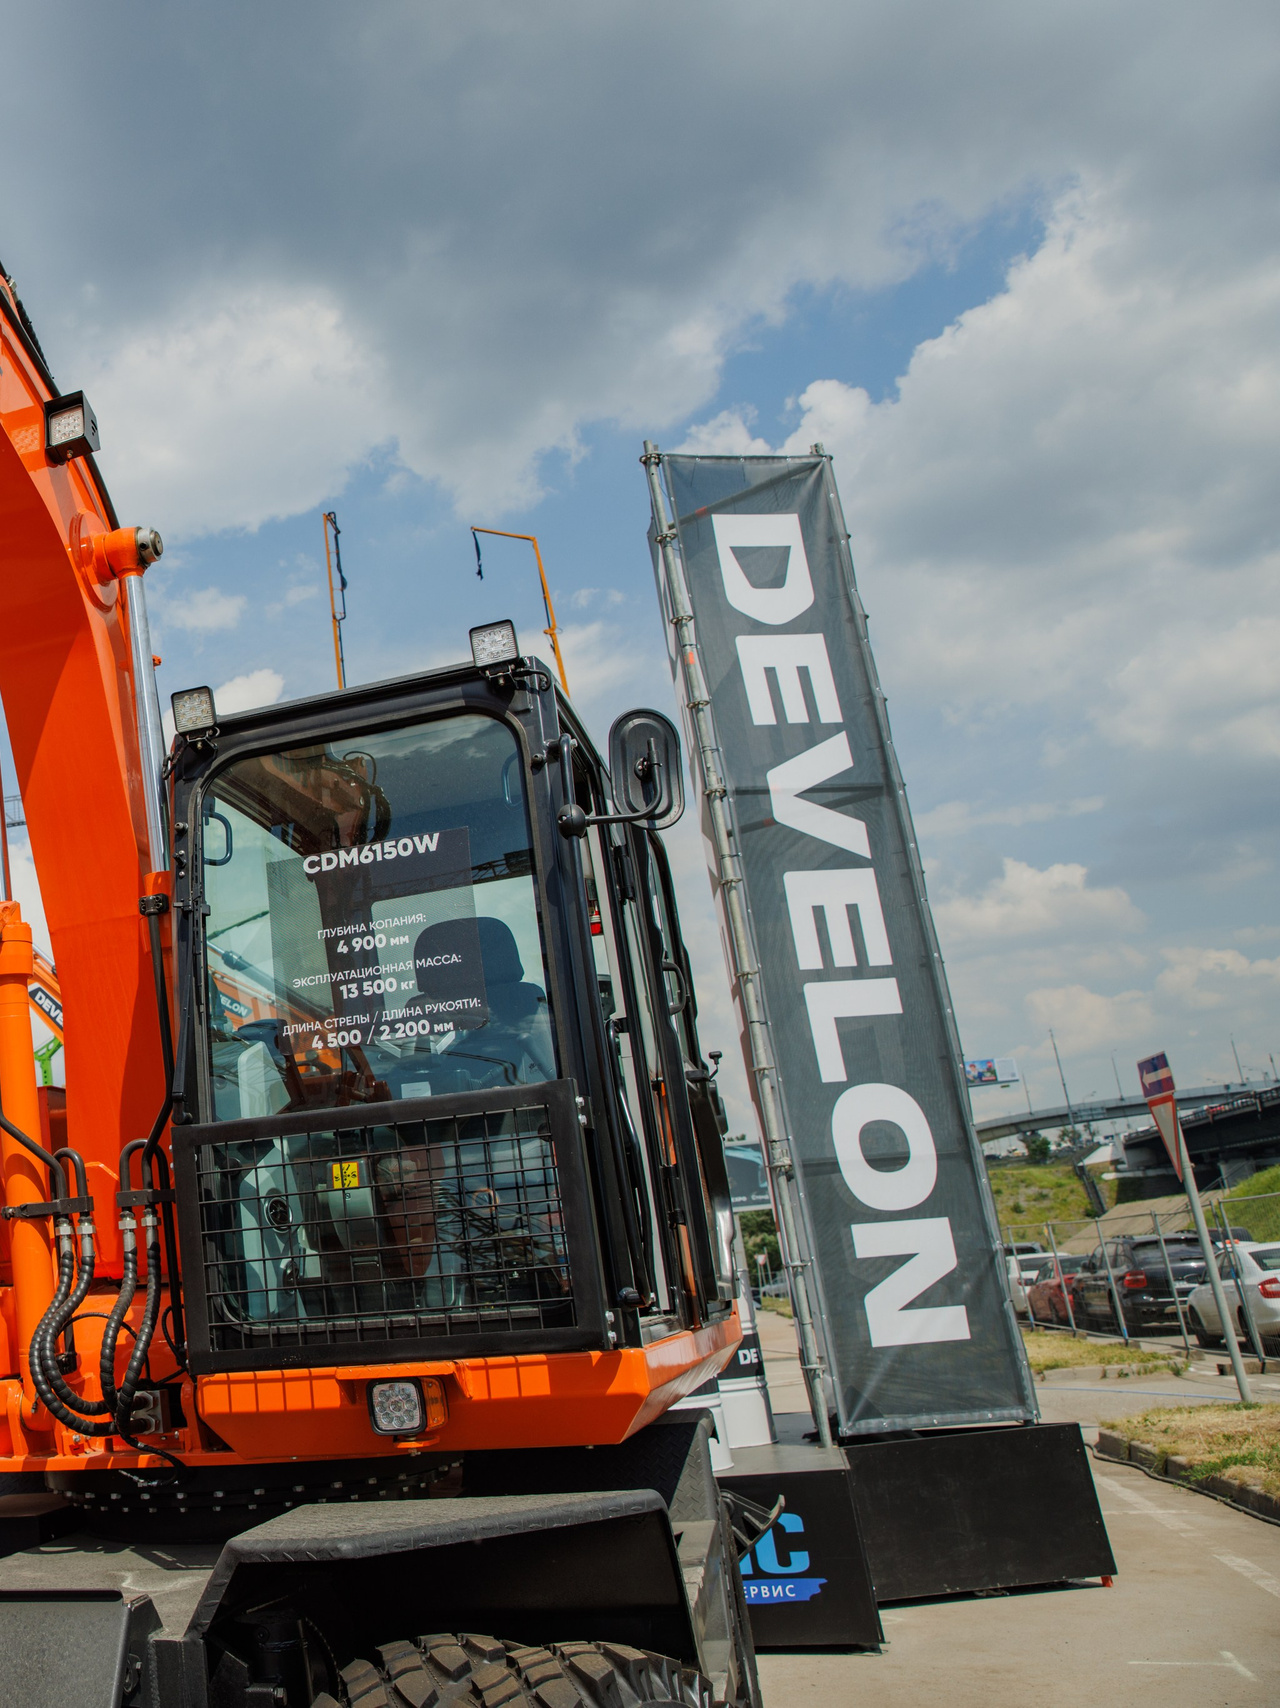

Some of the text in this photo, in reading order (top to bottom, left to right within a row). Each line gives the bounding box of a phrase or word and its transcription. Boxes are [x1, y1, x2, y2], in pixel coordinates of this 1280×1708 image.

[303, 832, 439, 874] CDM6150W
[317, 913, 427, 940] ГЛУБИНА КОПАНИЯ:
[711, 513, 971, 1348] DEVELON
[336, 934, 409, 954] 4 900 мм
[292, 953, 462, 988] ЭКСПЛУАТАЦИОННАЯ МАССА:
[339, 978, 416, 999] 13 500 кг
[282, 1021, 322, 1036] ДЛИНА
[324, 1013, 370, 1030] СТРЕЛЫ
[381, 1006, 423, 1023] ДЛИНА
[425, 997, 482, 1015] РУКОЯТИ:
[311, 1035, 324, 1049] 4
[327, 1029, 362, 1048] 500
[380, 1025, 392, 1041] 2
[394, 1019, 430, 1038] 200
[433, 1021, 454, 1033] мм
[738, 1348, 761, 1366] DE
